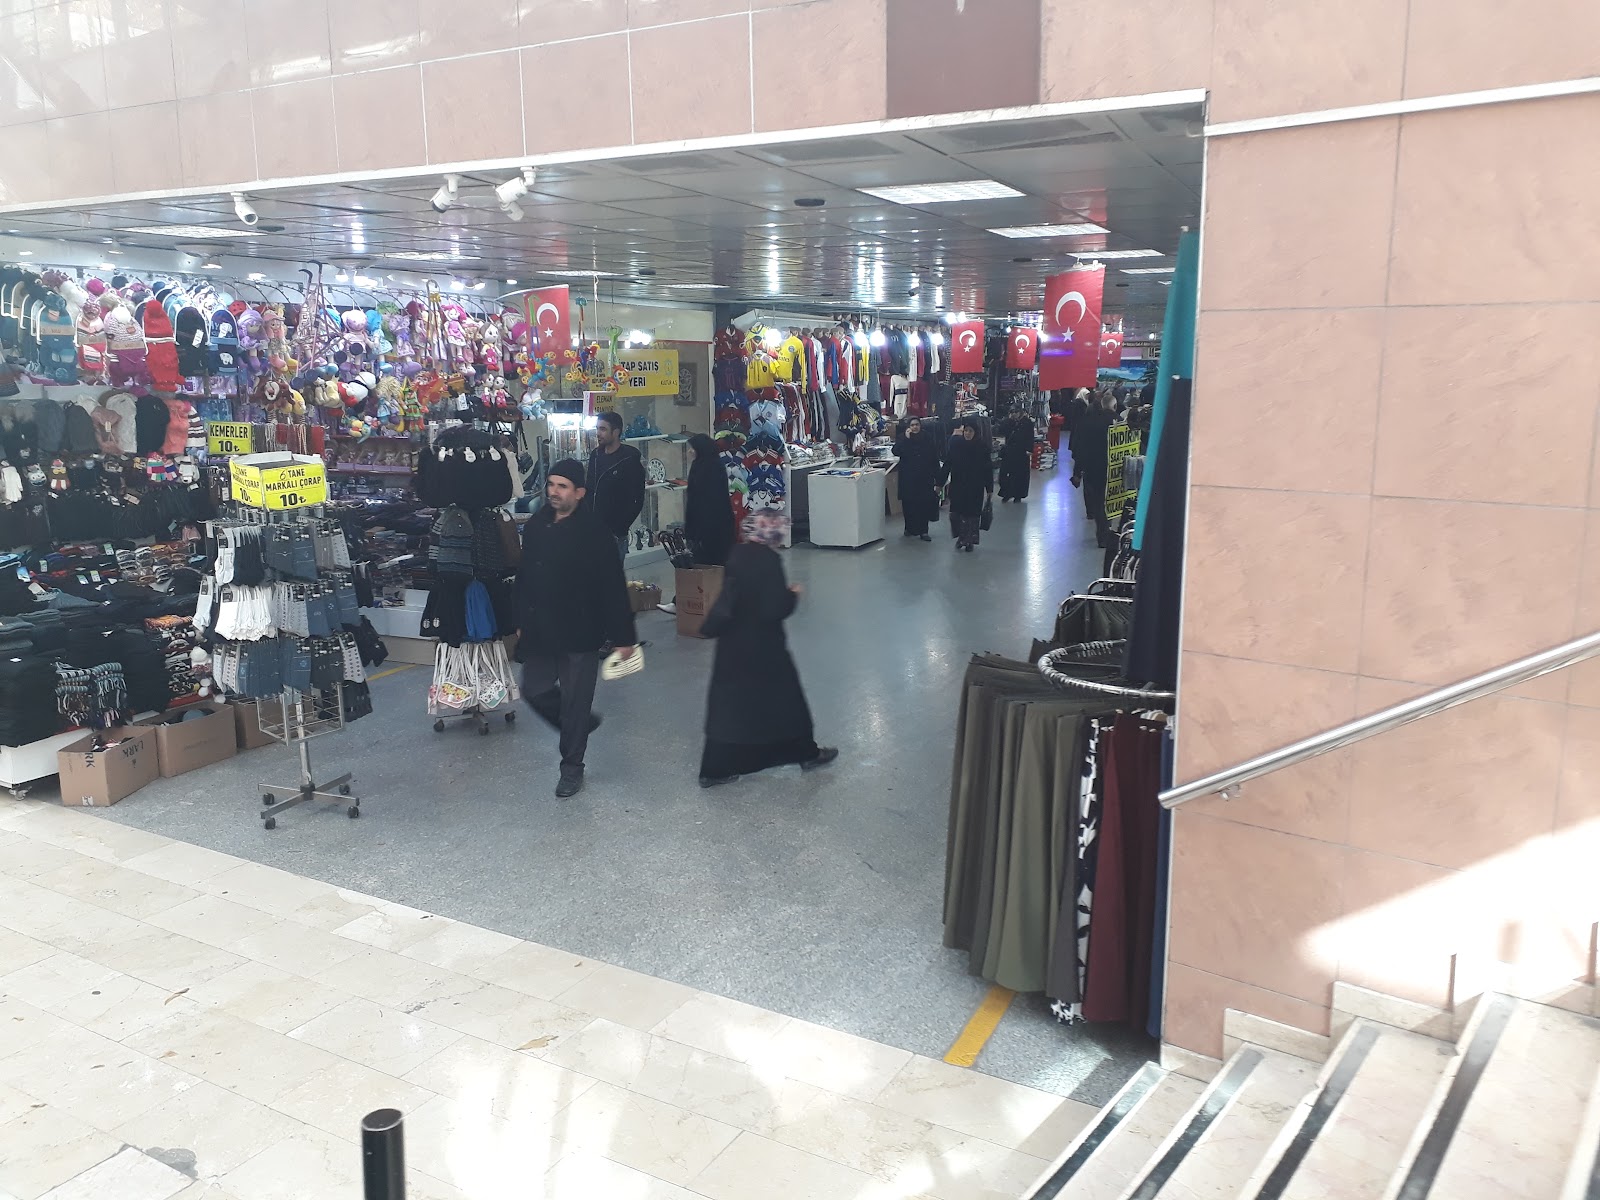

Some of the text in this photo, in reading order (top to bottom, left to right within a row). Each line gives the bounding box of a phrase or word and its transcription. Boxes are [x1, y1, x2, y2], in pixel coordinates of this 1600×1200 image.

[210, 424, 248, 439] KEMERLER
[287, 468, 306, 478] TANE
[265, 476, 322, 492] MARKALI ÇORAP
